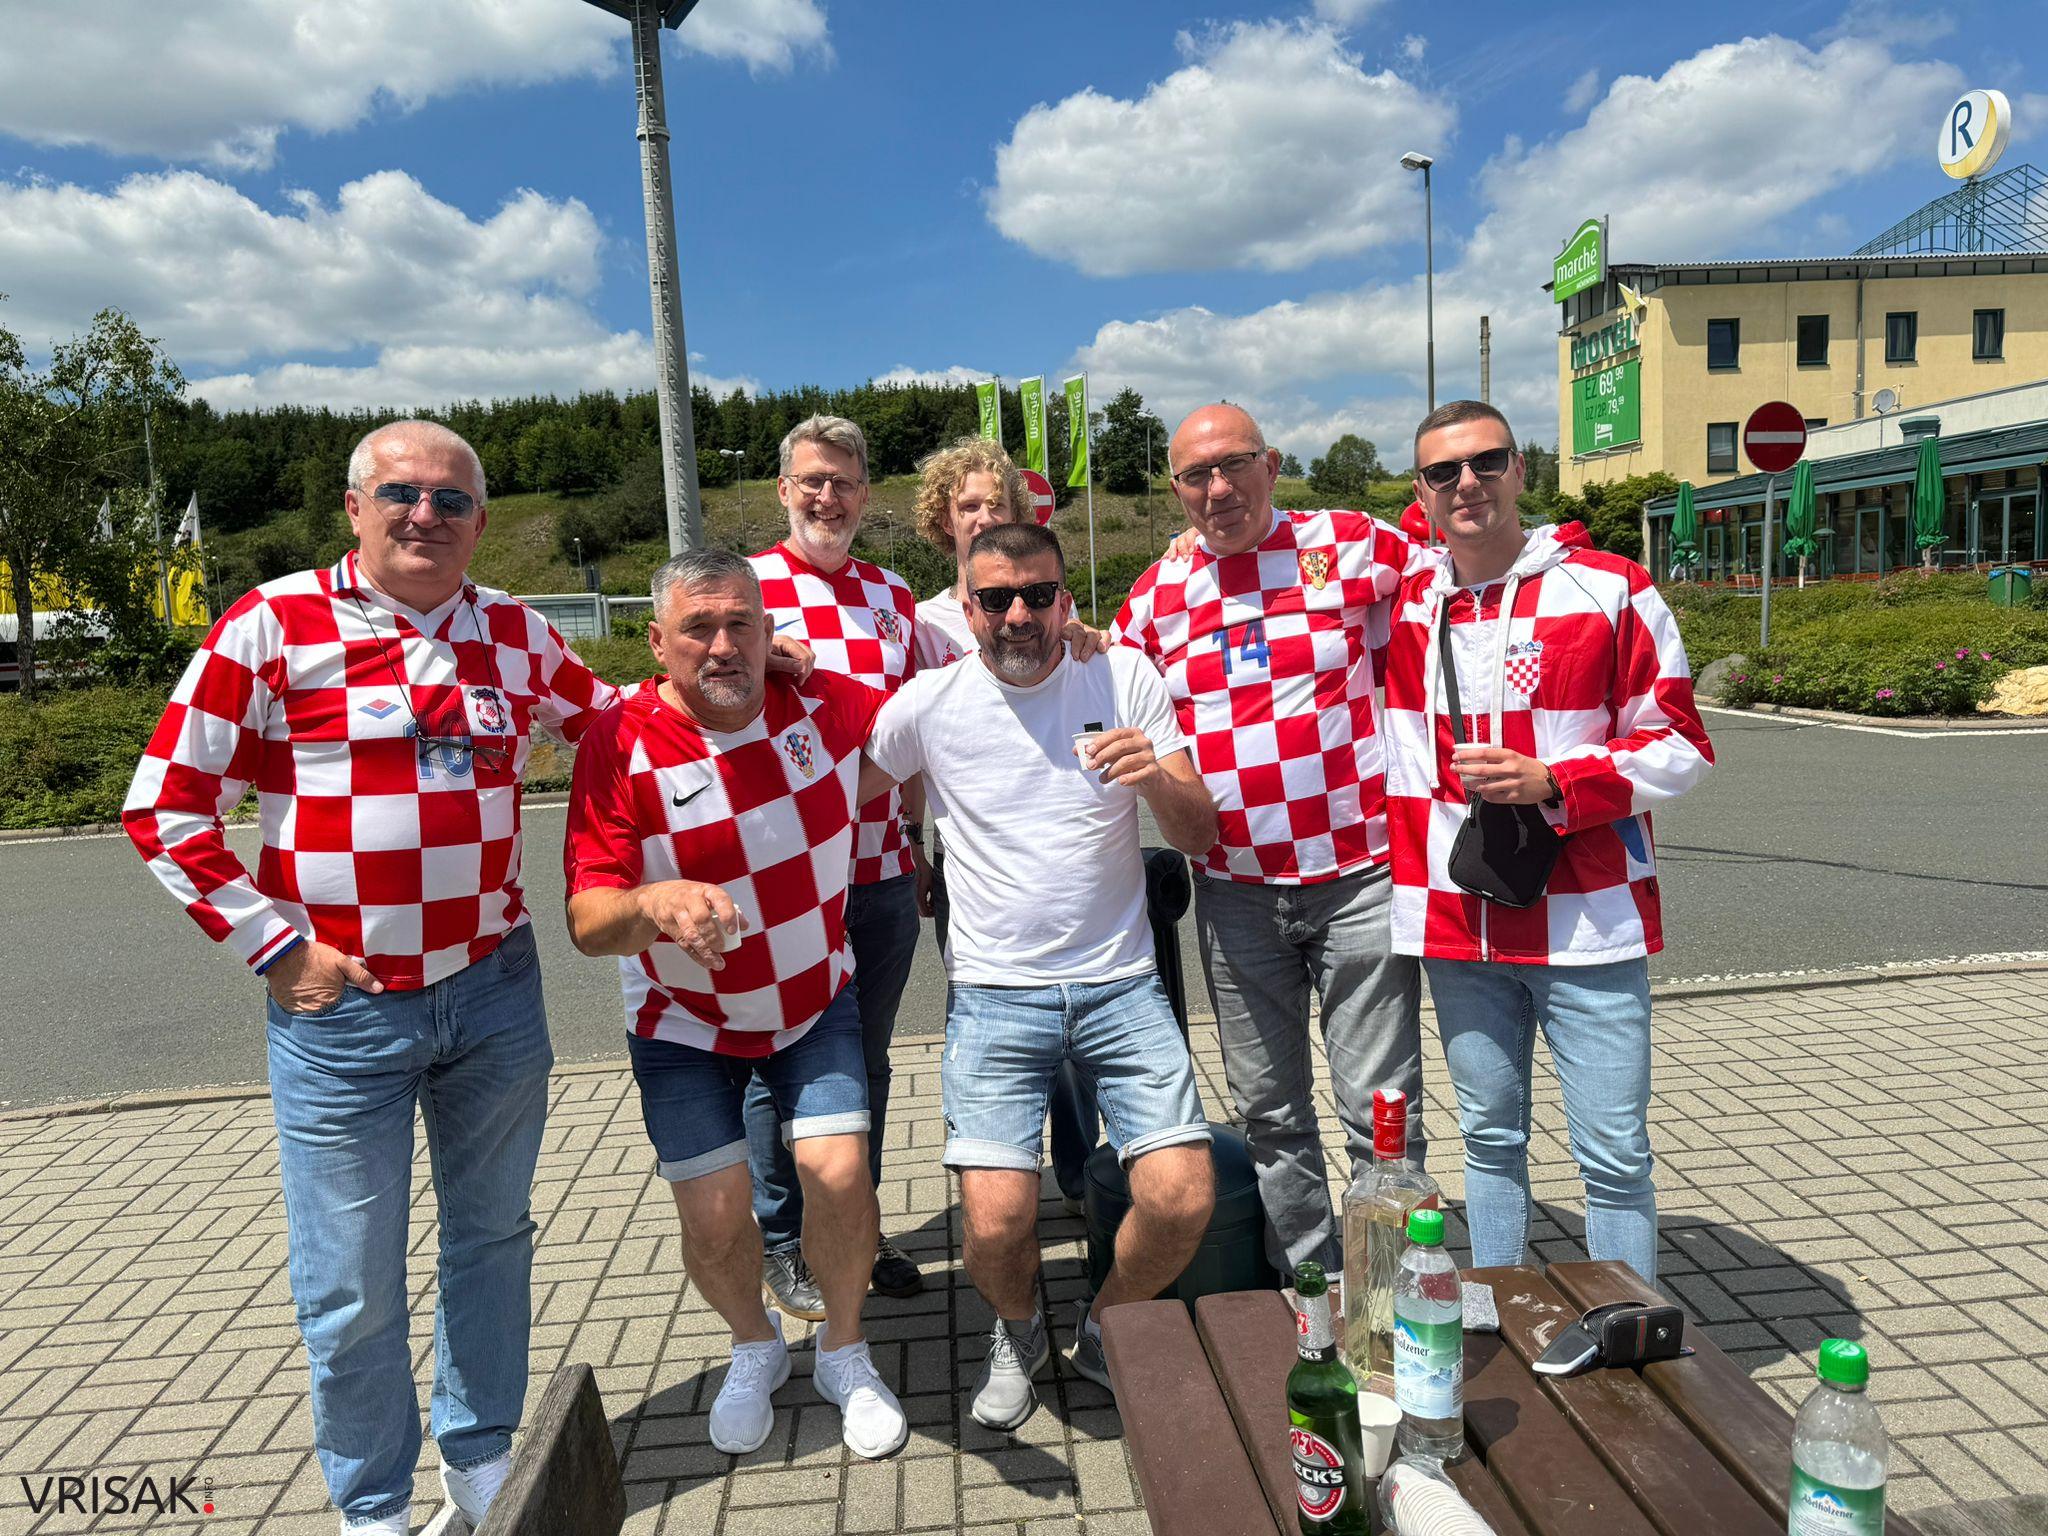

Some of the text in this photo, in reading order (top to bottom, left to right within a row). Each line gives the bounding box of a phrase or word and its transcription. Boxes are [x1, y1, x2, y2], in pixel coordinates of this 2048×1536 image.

[1951, 100, 1974, 157] R
[1556, 240, 1597, 284] marché
[1571, 314, 1638, 371] MOTEL
[1585, 377, 1598, 401] EZ
[1212, 617, 1272, 676] 14
[403, 708, 474, 780] 10
[1293, 1461, 1344, 1485] ECK'S
